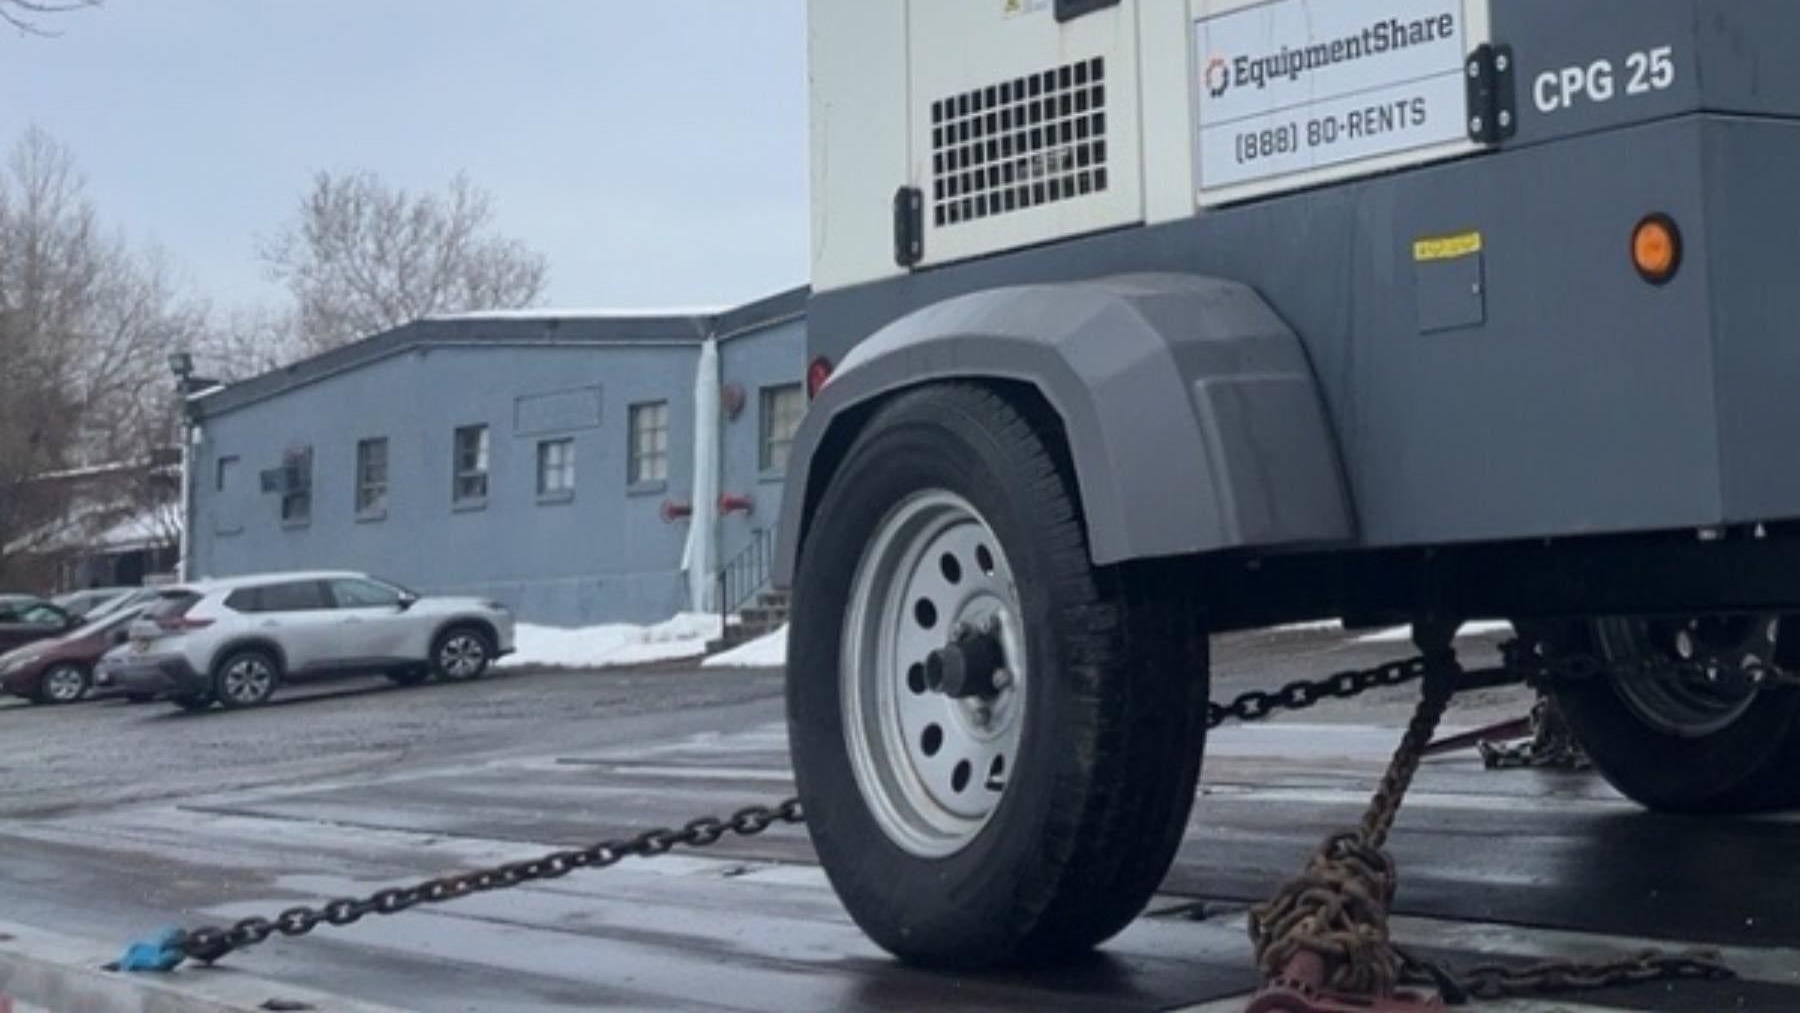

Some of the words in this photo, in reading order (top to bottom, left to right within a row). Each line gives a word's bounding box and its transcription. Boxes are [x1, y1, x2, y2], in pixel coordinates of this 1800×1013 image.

[1232, 12, 1454, 88] EquipmentShare
[1533, 58, 1613, 113] CPG
[1625, 45, 1675, 96] 25
[1235, 121, 1298, 164] (888)
